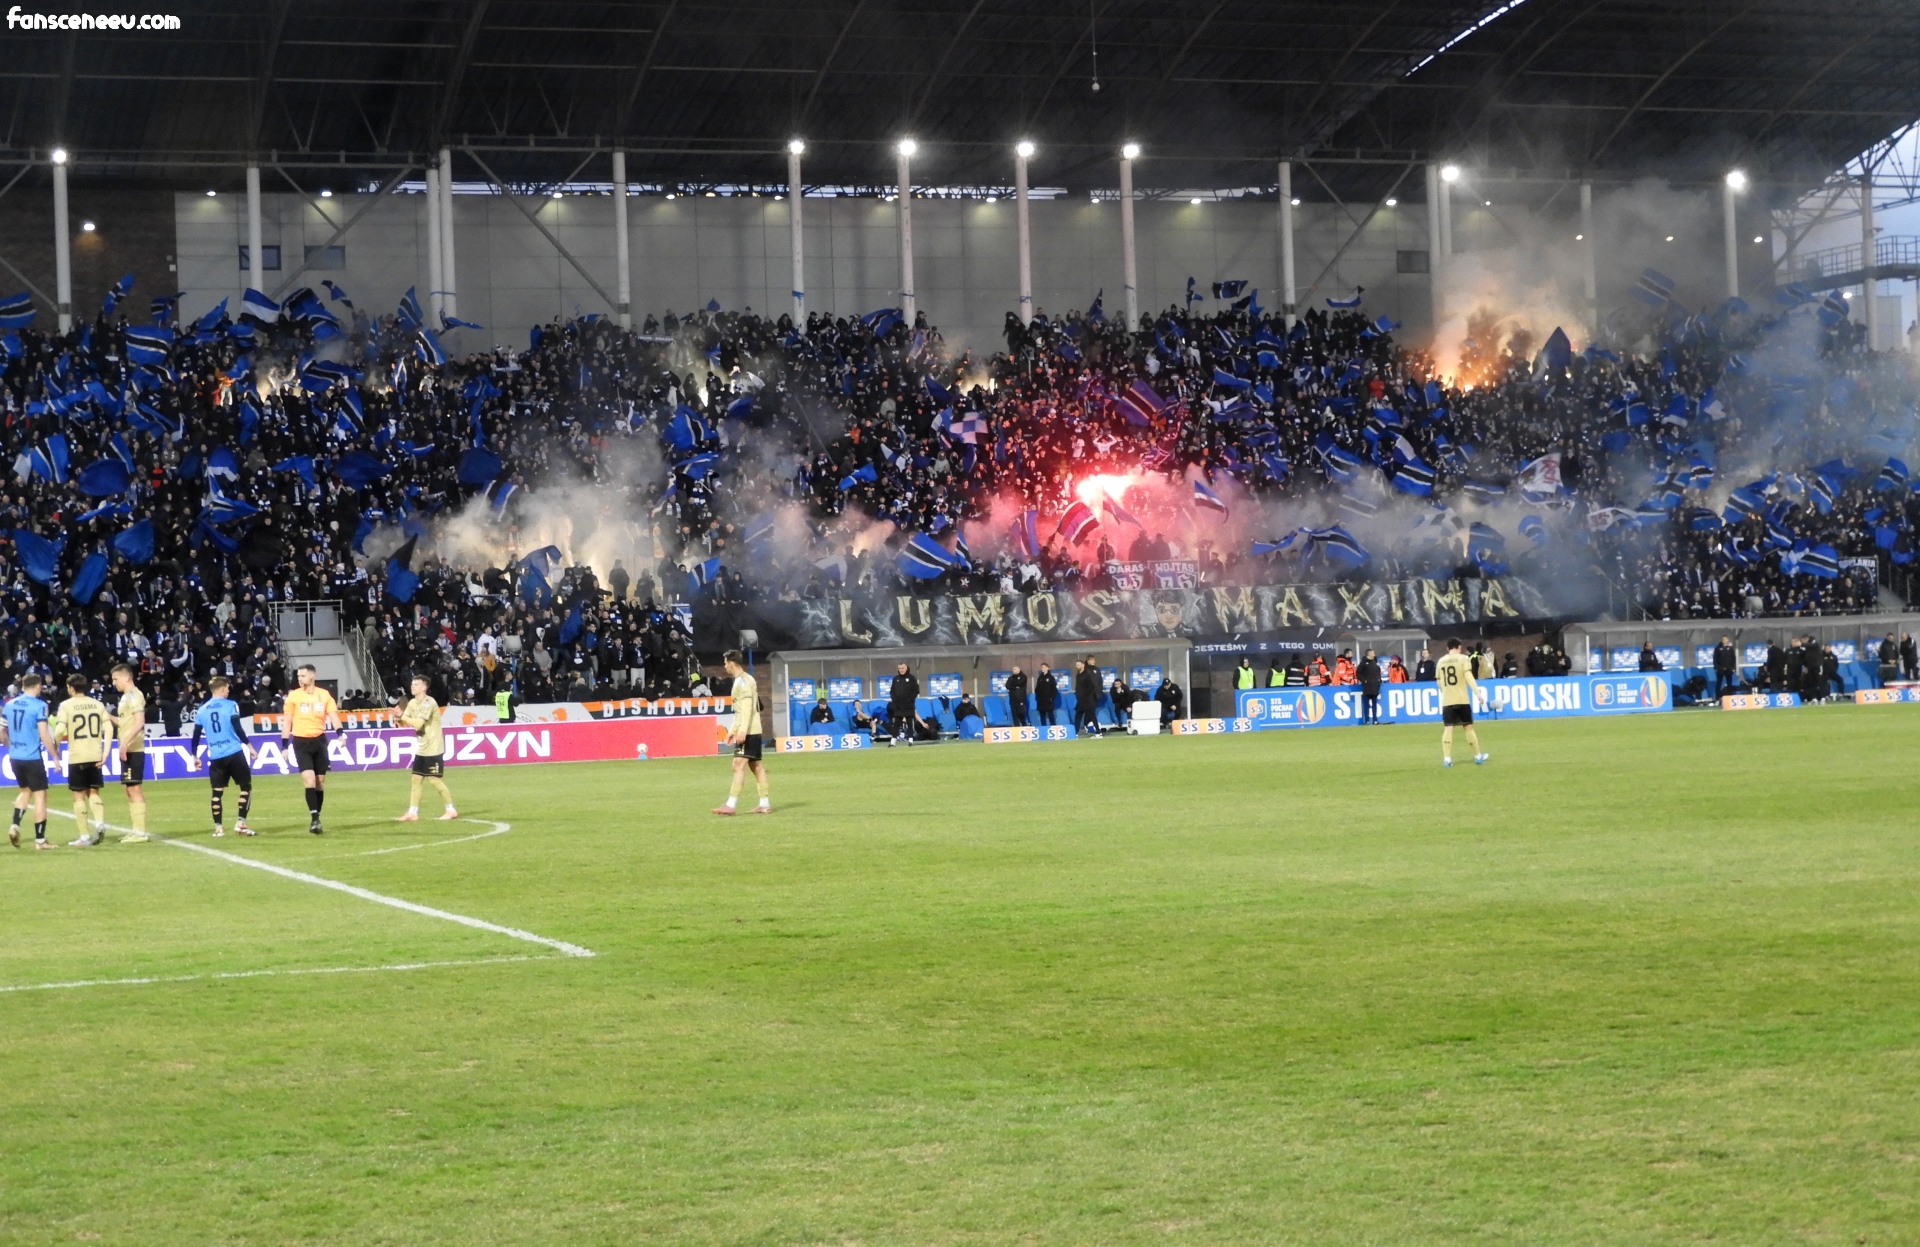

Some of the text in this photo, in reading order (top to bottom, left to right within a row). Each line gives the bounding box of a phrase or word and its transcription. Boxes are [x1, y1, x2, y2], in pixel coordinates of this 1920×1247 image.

[1108, 563, 1145, 574] DARAS
[1155, 562, 1195, 573] WOJTAS
[840, 578, 1519, 646] LUMOS MAXIMA
[1195, 642, 1248, 653] JESTEŚMY
[1260, 642, 1268, 650] Z
[1279, 641, 1305, 650] TEGO
[1441, 665, 1458, 687] 18
[1495, 682, 1581, 714] POLSKI
[13, 708, 26, 733] 17
[72, 712, 101, 741] 20
[210, 711, 221, 734] 8
